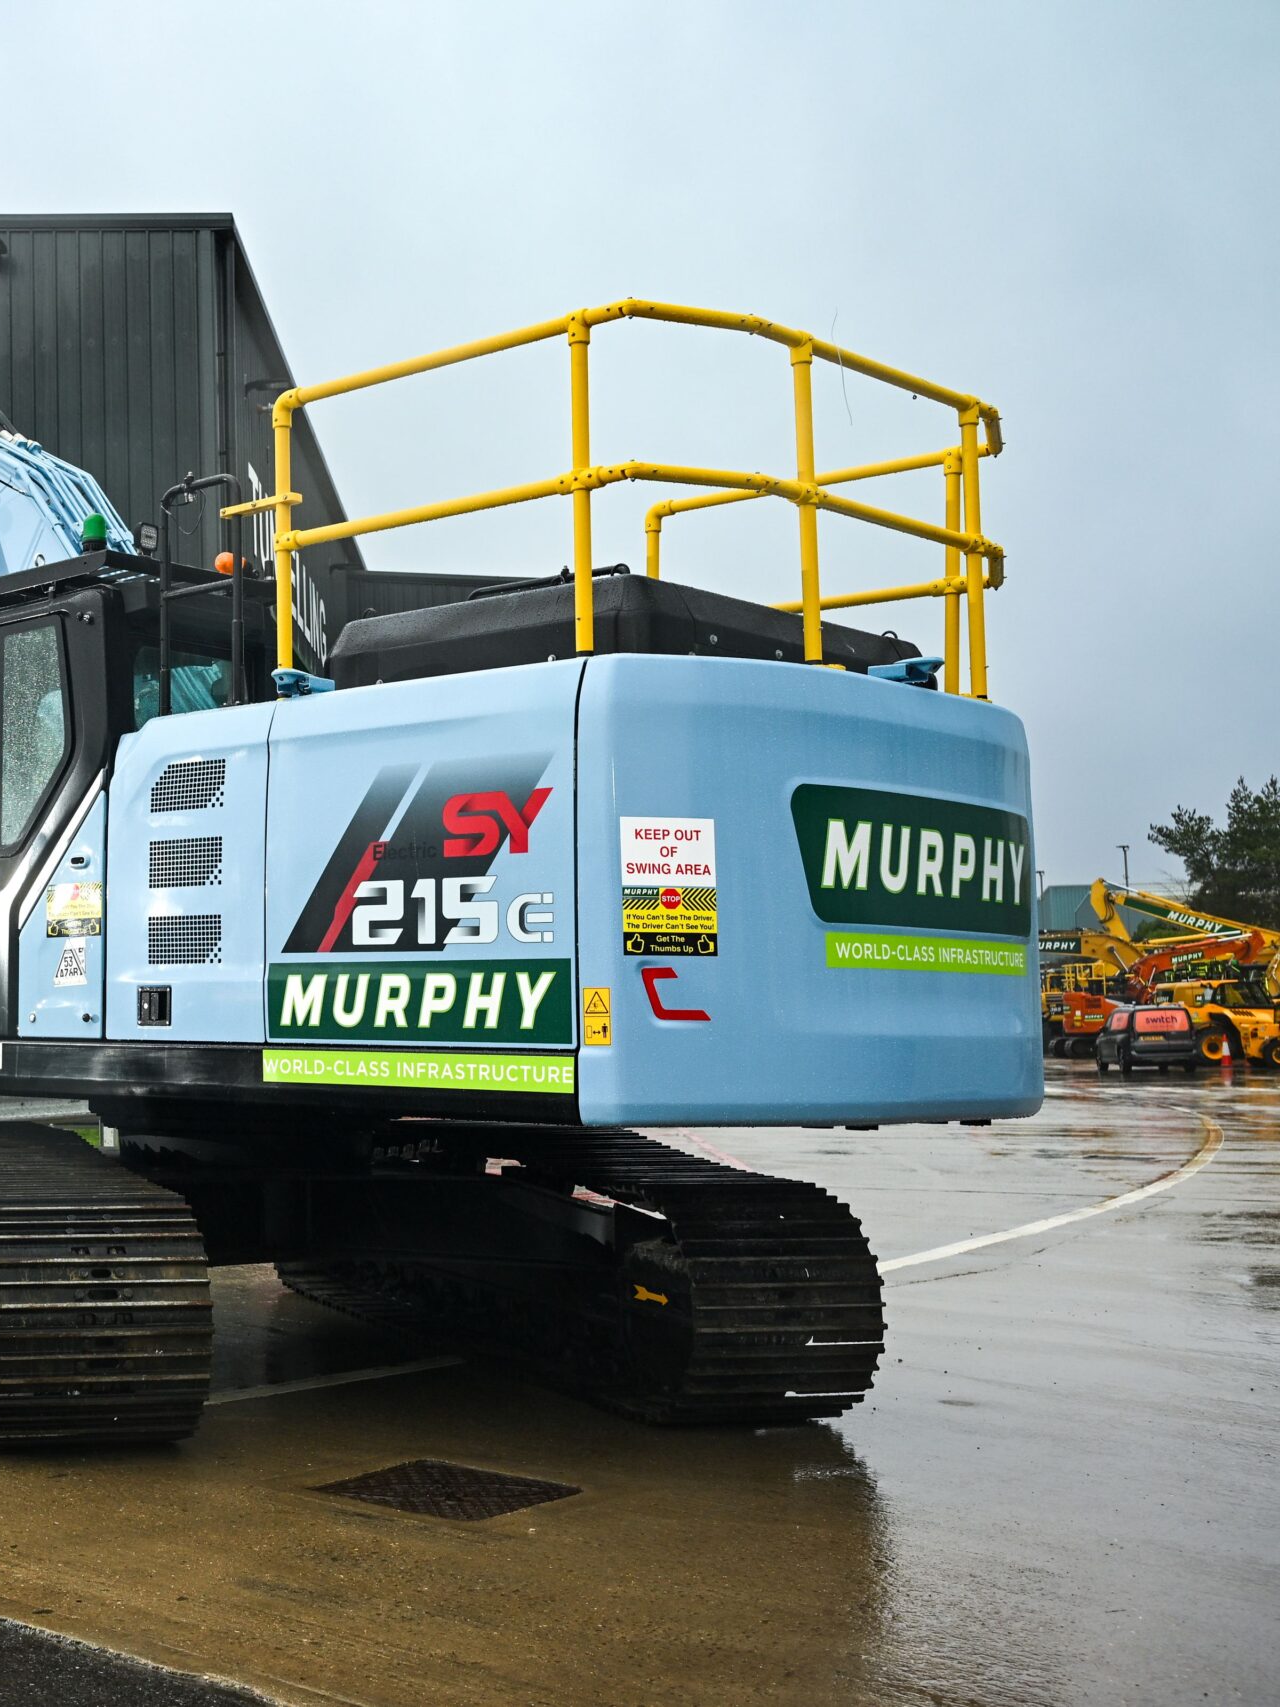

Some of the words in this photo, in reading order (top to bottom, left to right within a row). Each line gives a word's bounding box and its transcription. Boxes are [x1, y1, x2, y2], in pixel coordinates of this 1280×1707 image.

[248, 462, 327, 668] TUNLLING
[442, 787, 553, 858] SY
[634, 828, 670, 841] KEEP
[674, 829, 701, 841] OUT
[373, 841, 437, 861] Electric
[660, 846, 678, 858] OF
[626, 862, 671, 875] SWING
[675, 863, 711, 876] AREA
[821, 818, 1024, 906] MURPHY
[1167, 910, 1223, 933] MURPHY
[656, 935, 670, 943] Get
[670, 935, 685, 943] The
[1039, 941, 1076, 950] URPHY
[650, 944, 681, 952] Thumbs
[683, 945, 694, 954] Up
[835, 942, 935, 962] WORLD-CLASS
[938, 947, 1024, 968] INFRASTRUCTURE
[63, 956, 74, 968] 53
[1171, 951, 1203, 963] MURPHY
[279, 971, 556, 1029] MURPHY
[1145, 1015, 1178, 1025] switch
[263, 1058, 390, 1078] WORLD-CLASS
[396, 1061, 573, 1084] INFRASTRUCTURE
